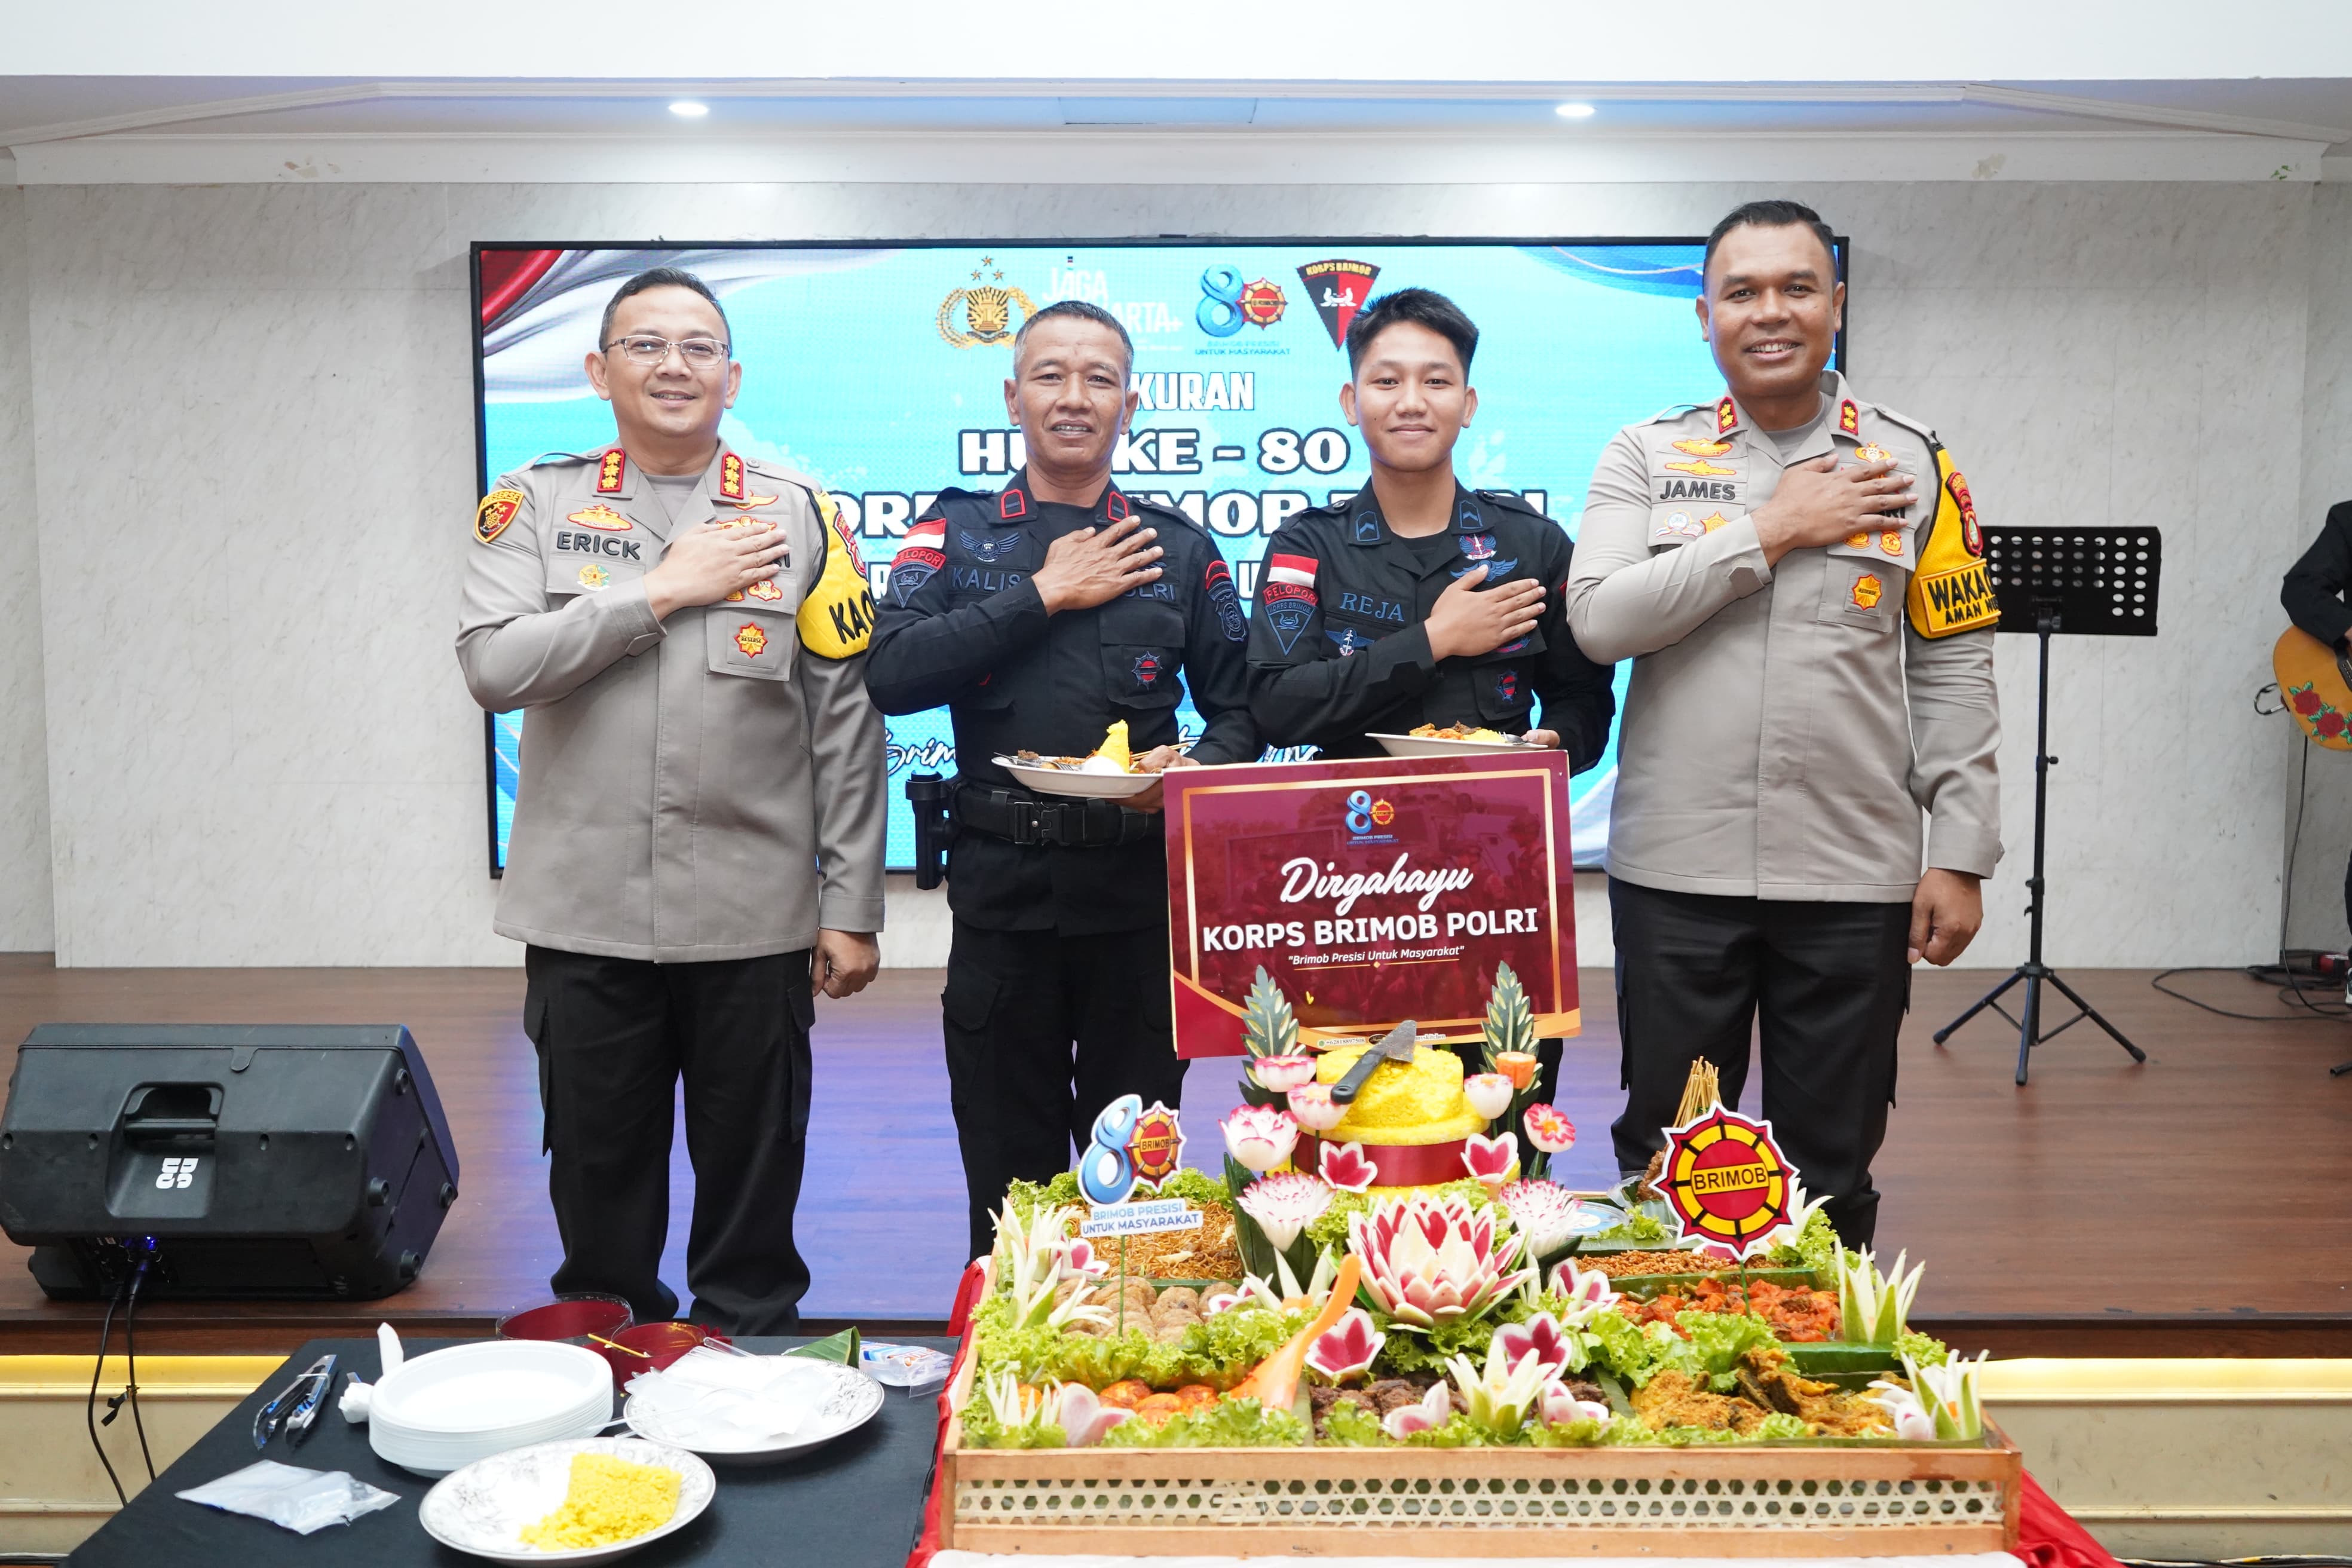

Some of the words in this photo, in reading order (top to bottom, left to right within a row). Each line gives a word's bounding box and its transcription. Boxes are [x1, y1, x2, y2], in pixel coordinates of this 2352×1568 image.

[1305, 262, 1336, 276] KORPS
[1042, 267, 1109, 302] JAGA
[1105, 301, 1183, 334] ARTA+
[1128, 371, 1255, 411] KURAN
[1257, 427, 1350, 475] 80
[1659, 479, 1736, 501] JAMES
[556, 531, 641, 561] ERICK
[1266, 584, 1316, 602] PELOPOR
[1269, 602, 1288, 613] KORPS
[1288, 602, 1312, 613] BRIMOB
[1339, 592, 1405, 622] REJA
[1945, 602, 1982, 626] AMAN
[740, 636, 762, 644] RESERSE
[1280, 852, 1474, 917] Dirgahayu
[1202, 921, 1306, 952] KORPS
[1313, 913, 1438, 946] BRIMOB
[1446, 907, 1539, 937] POLRI
[1288, 953, 1329, 966] "Brimob
[1331, 951, 1365, 963] Presisi
[1367, 949, 1398, 961] Untuk
[1400, 945, 1465, 959] Masyarakat"
[1141, 1138, 1170, 1151] BRIMOB
[1693, 1166, 1767, 1190] BRIMOB
[1094, 1207, 1135, 1221] BRIMOB
[1138, 1202, 1183, 1215] PRESISI
[1083, 1222, 1115, 1235] UNTUK
[1117, 1213, 1199, 1230] MASYARAKAT
